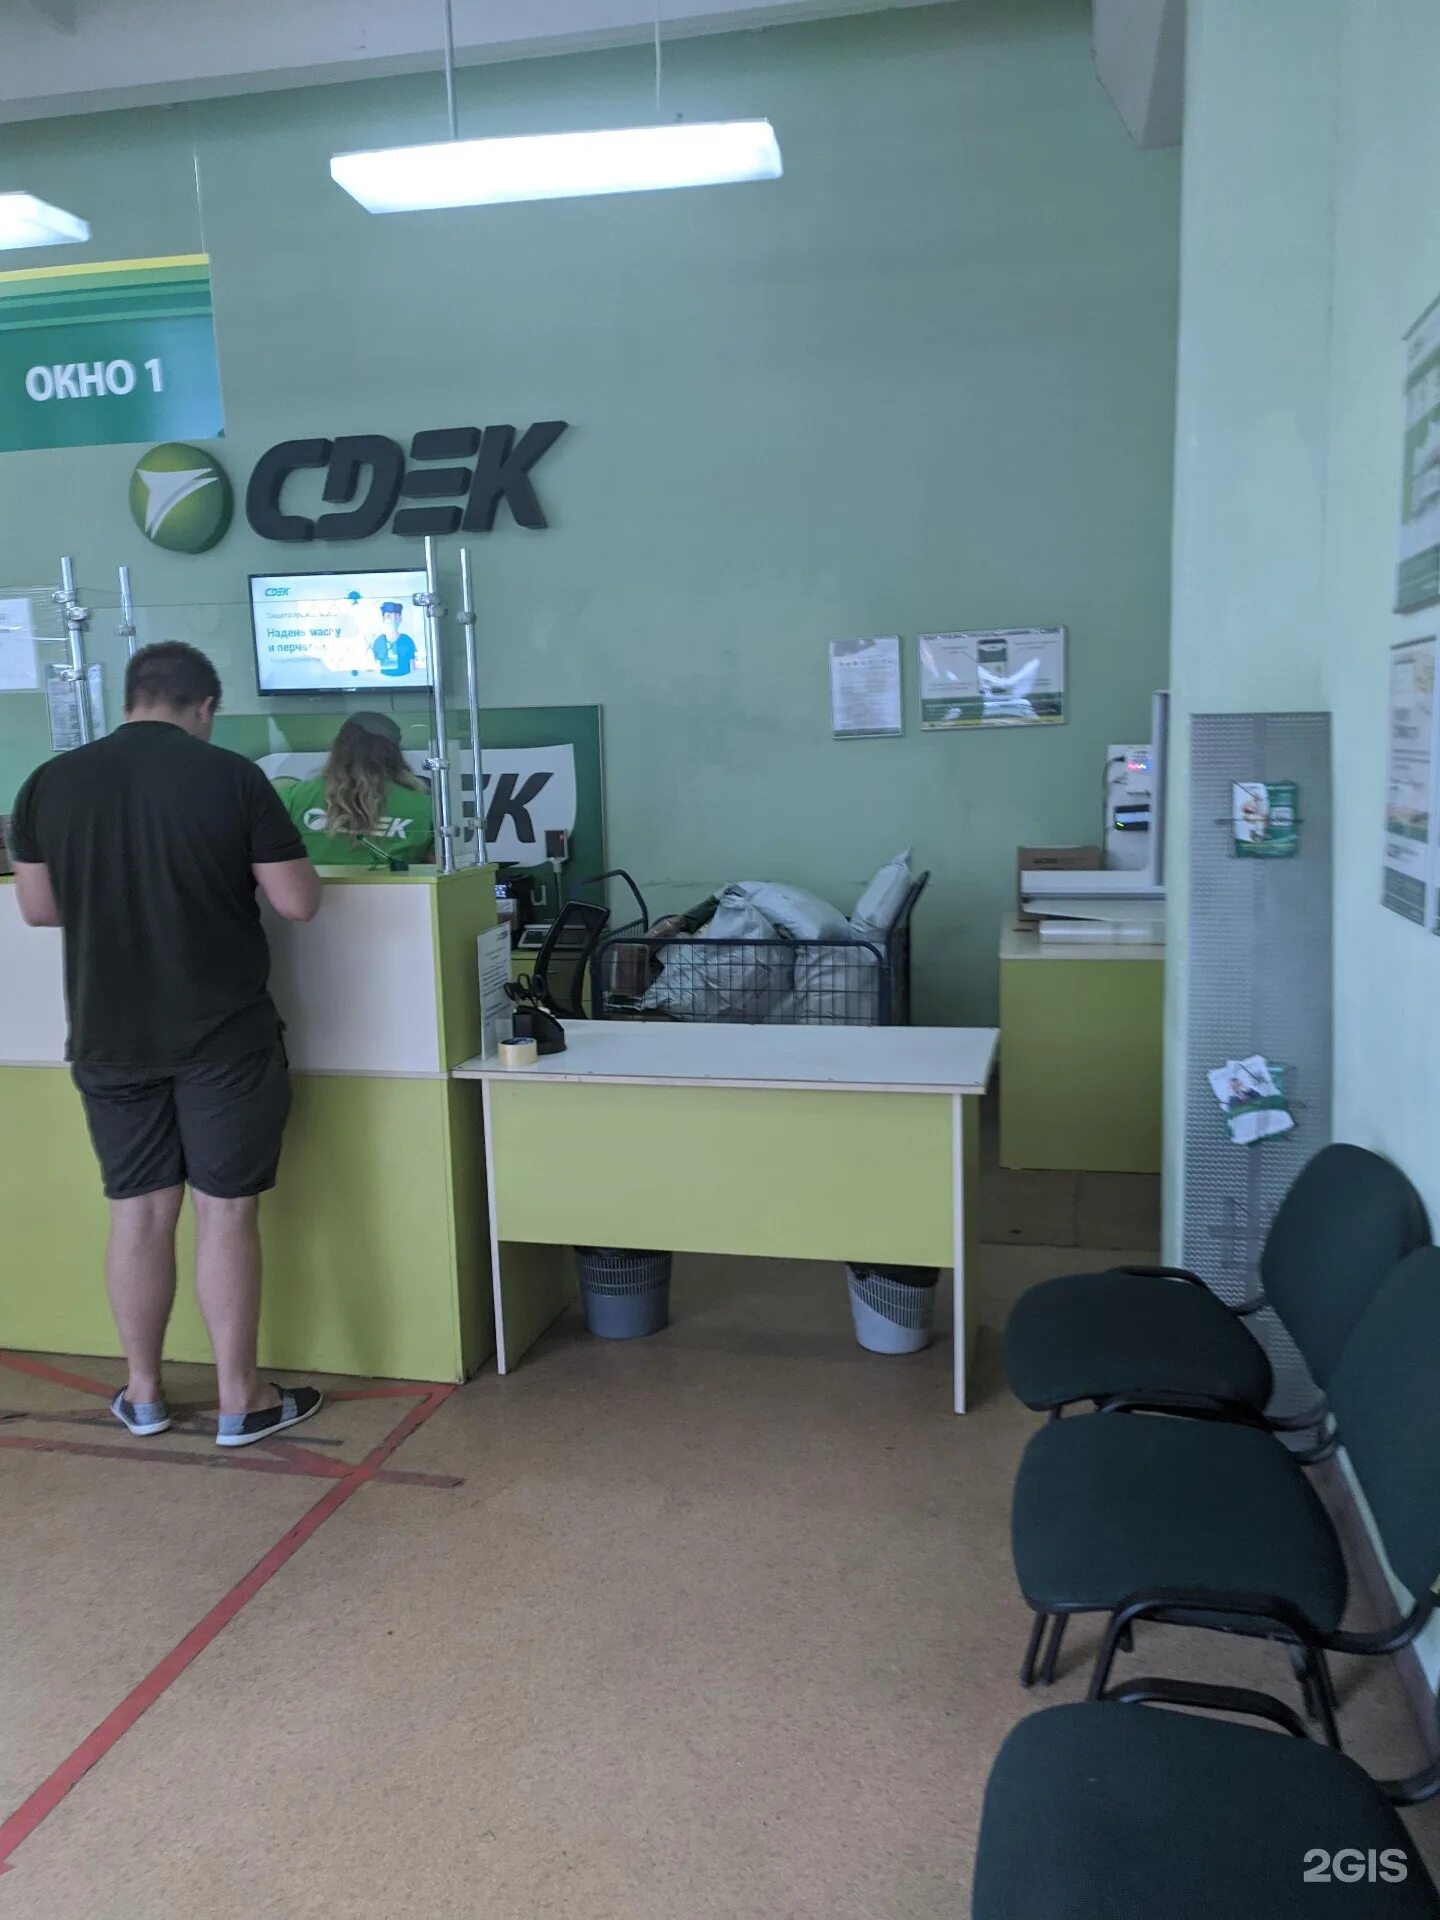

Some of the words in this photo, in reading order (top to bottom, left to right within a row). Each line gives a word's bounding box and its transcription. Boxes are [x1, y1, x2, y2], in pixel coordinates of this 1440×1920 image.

[25, 359, 136, 401] ОКНО
[144, 358, 164, 393] 1
[246, 420, 568, 542] CDEK
[264, 587, 291, 597] CDEK
